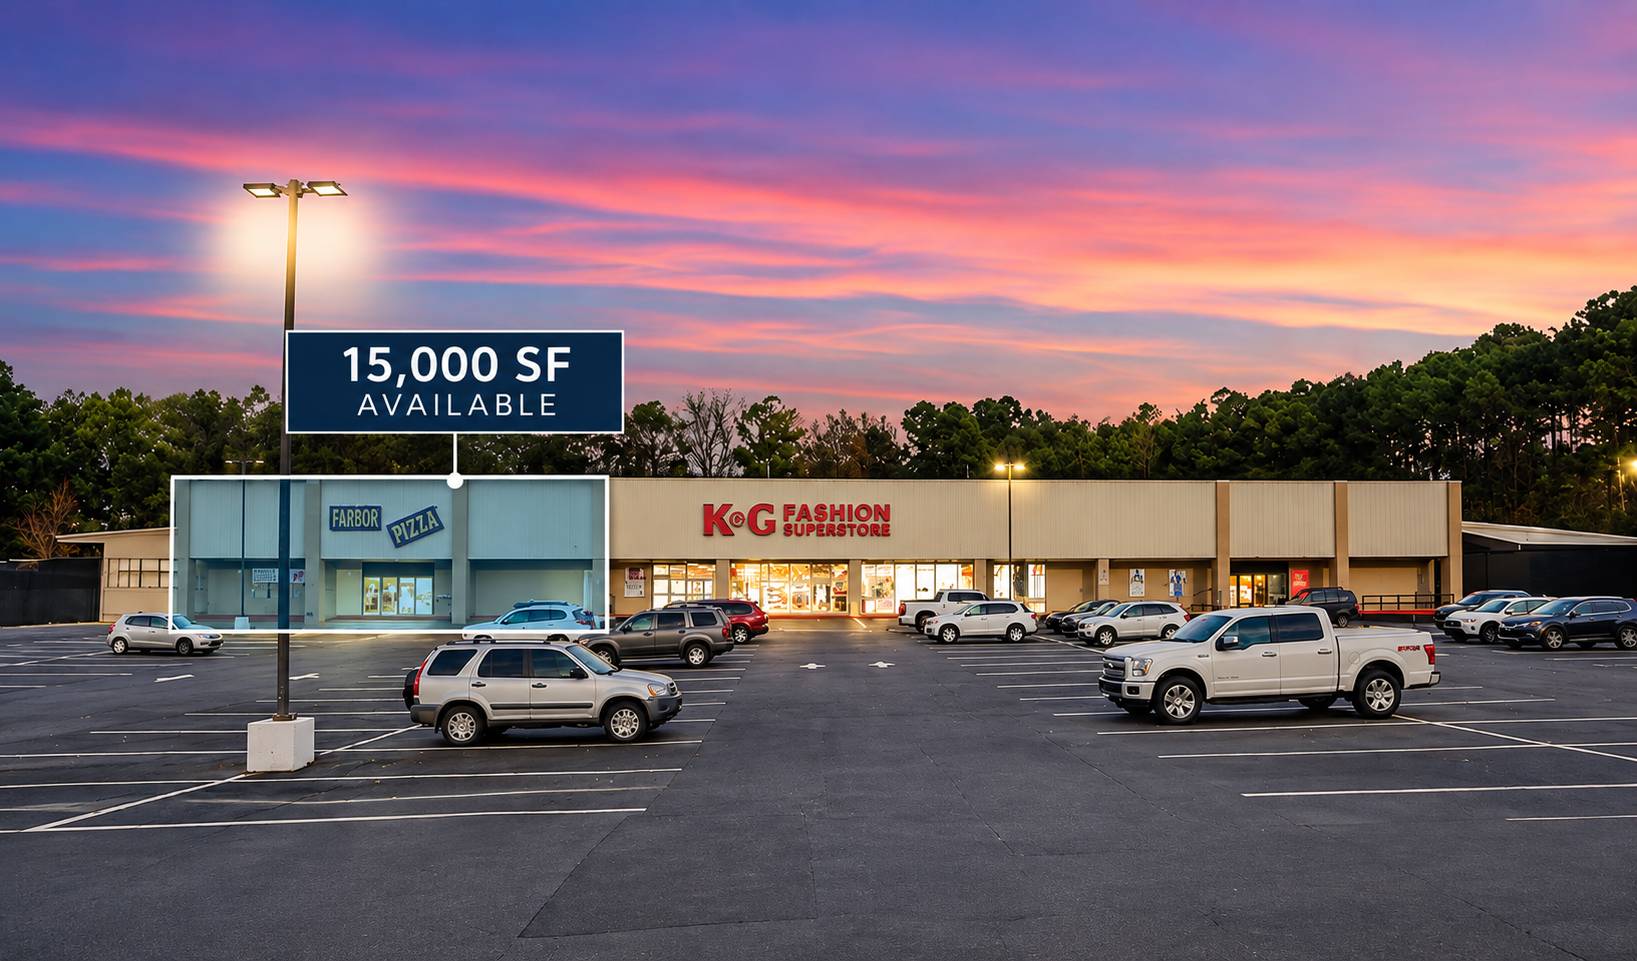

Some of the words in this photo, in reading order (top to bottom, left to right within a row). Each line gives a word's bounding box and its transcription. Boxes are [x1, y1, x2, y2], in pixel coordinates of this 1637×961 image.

[332, 508, 379, 528] FARBOR
[783, 503, 891, 522] FASHION
[391, 511, 439, 544] PIZZA
[783, 523, 891, 537] SUPERSTORE
